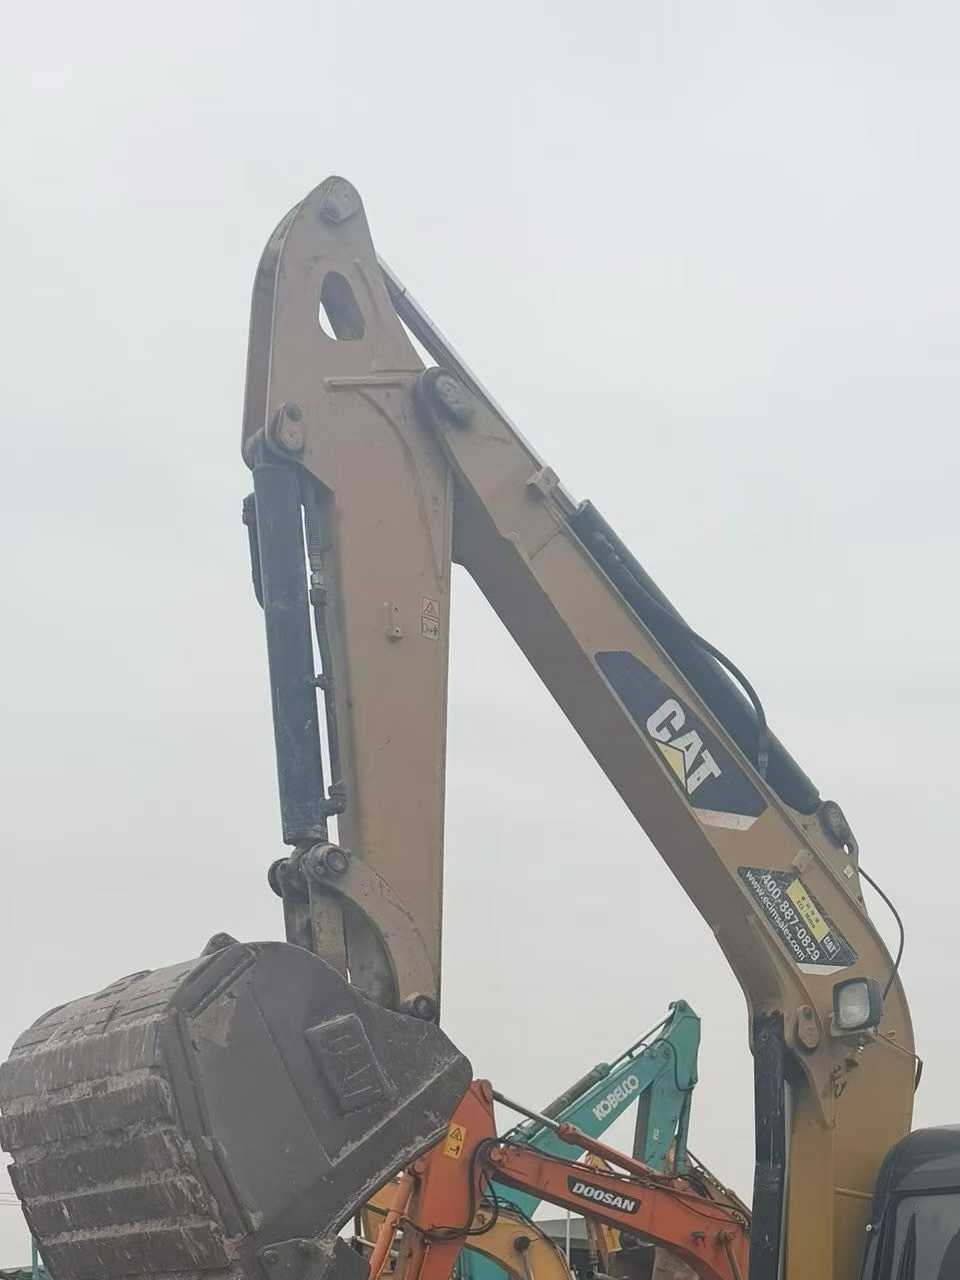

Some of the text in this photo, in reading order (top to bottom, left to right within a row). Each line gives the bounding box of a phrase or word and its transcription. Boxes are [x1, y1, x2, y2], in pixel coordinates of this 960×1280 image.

[646, 698, 722, 795] CAT
[761, 874, 820, 961] 400-887-0829
[823, 935, 837, 954] CAT
[592, 1074, 640, 1121] KOBELCO
[572, 1182, 636, 1212] DOOSAN
